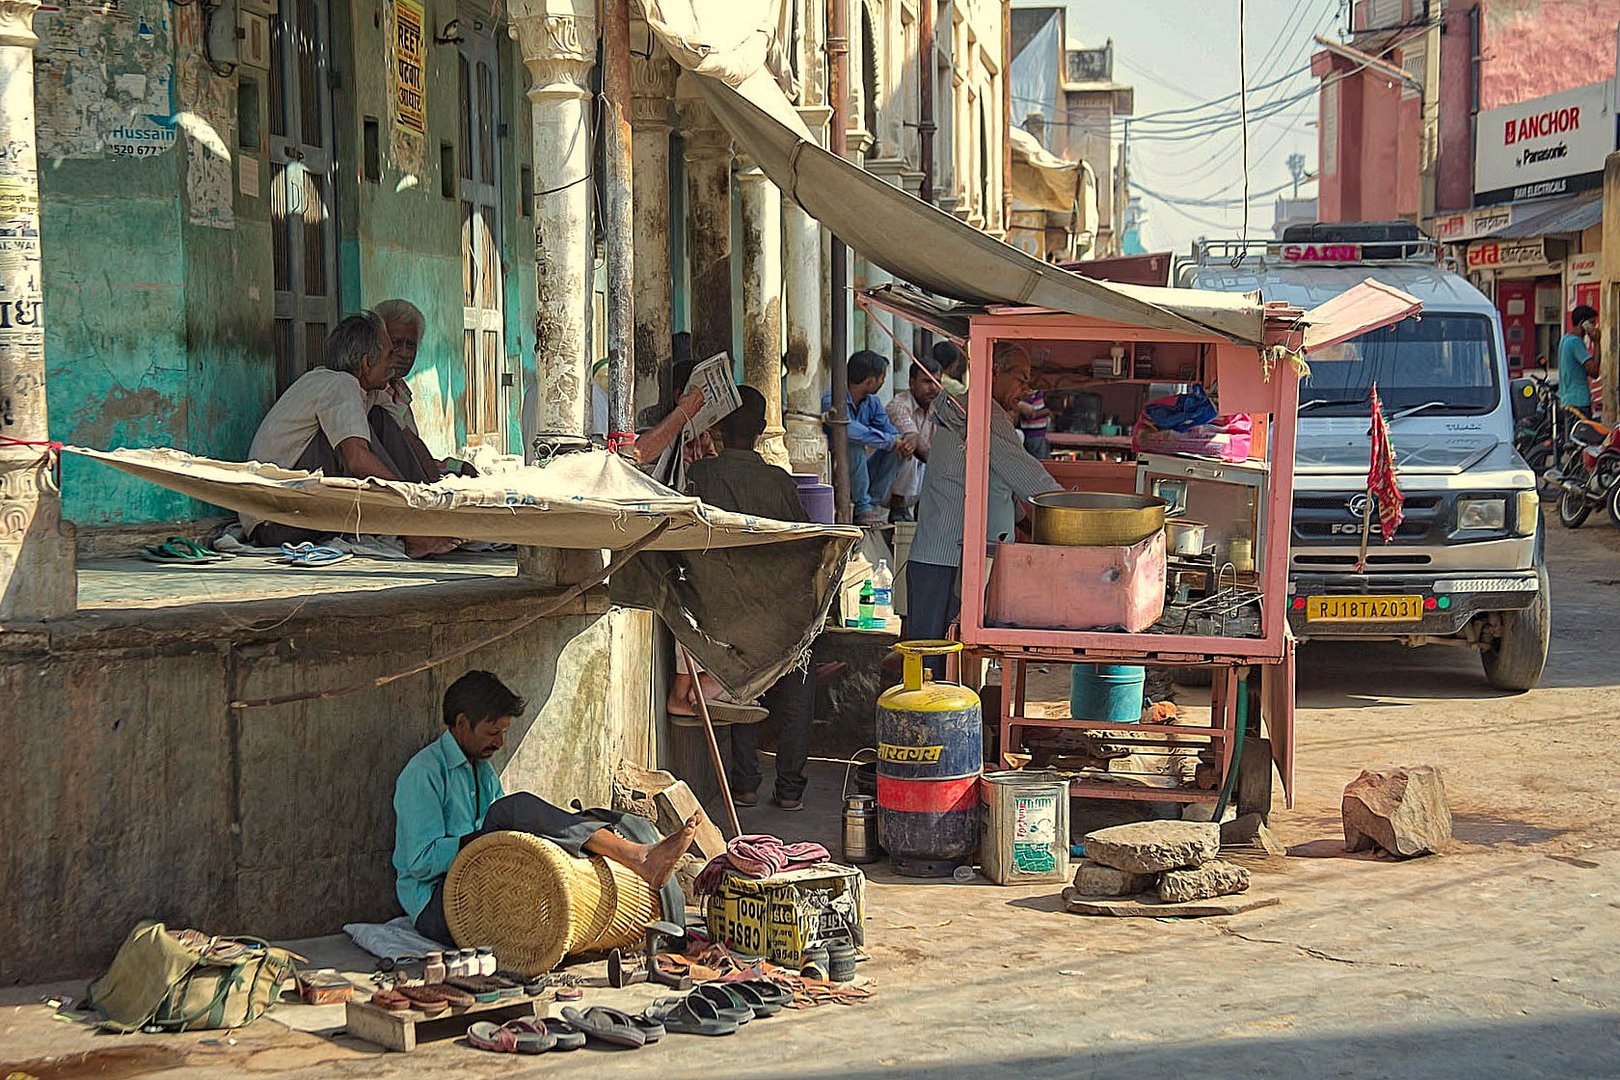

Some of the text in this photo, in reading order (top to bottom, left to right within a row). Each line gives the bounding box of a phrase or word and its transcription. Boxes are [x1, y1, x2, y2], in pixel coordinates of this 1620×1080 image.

[398, 25, 421, 55] REET
[113, 126, 175, 140] Hussain
[1518, 107, 1580, 142] ANCHOR
[1523, 141, 1568, 166] Panasonic
[1284, 244, 1358, 262] SAINI
[1469, 243, 1500, 266] रवि
[1320, 601, 1417, 618] RJ18TA2031
[1016, 802, 1026, 838] Fortune
[728, 920, 761, 951] CBSE
